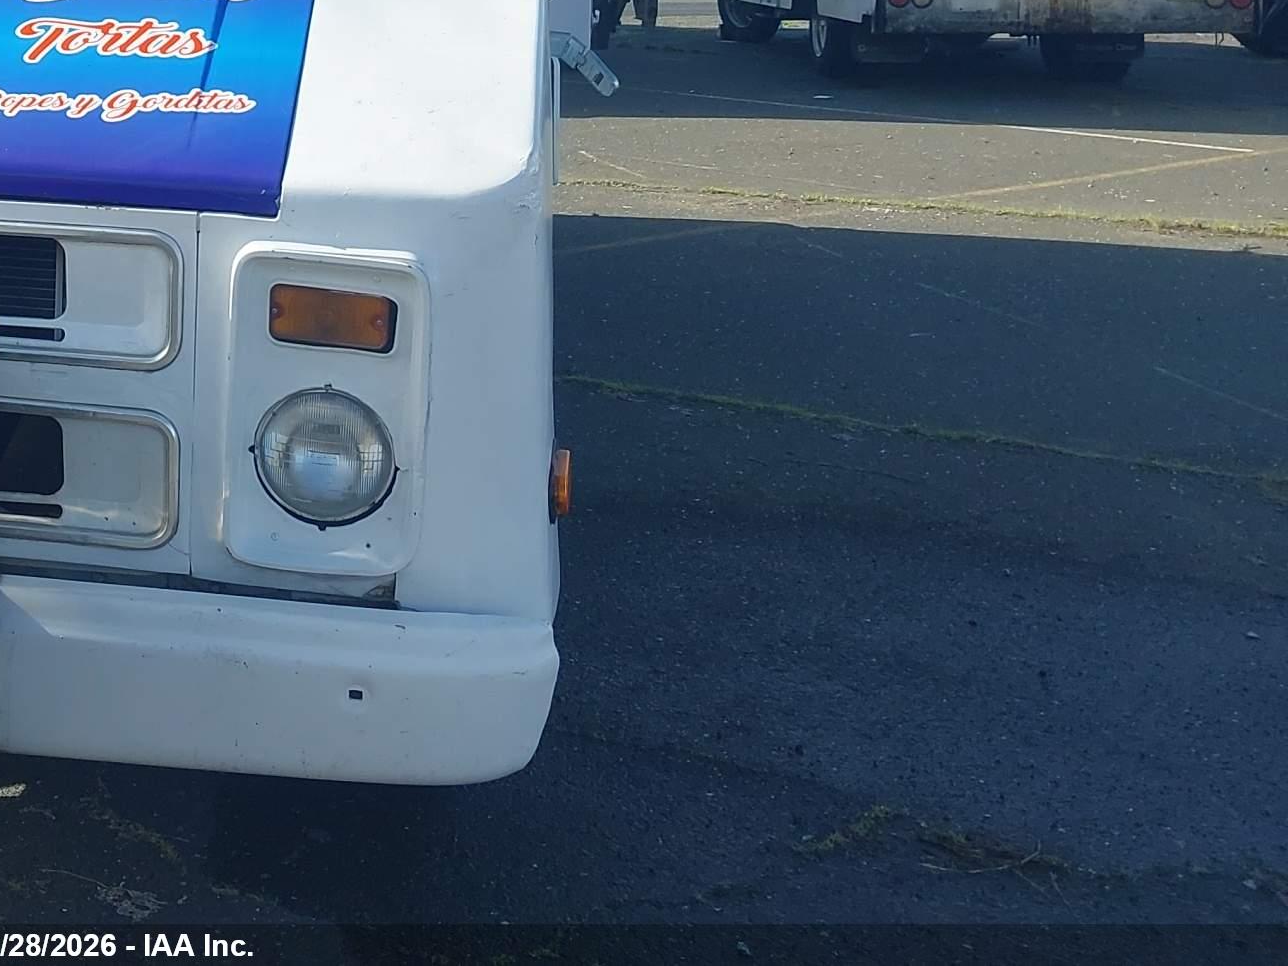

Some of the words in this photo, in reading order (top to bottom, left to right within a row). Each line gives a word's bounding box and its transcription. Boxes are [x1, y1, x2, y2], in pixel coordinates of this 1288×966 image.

[16, 16, 218, 64] Tortas
[69, 94, 102, 119] y
[100, 87, 258, 123] Gorditas
